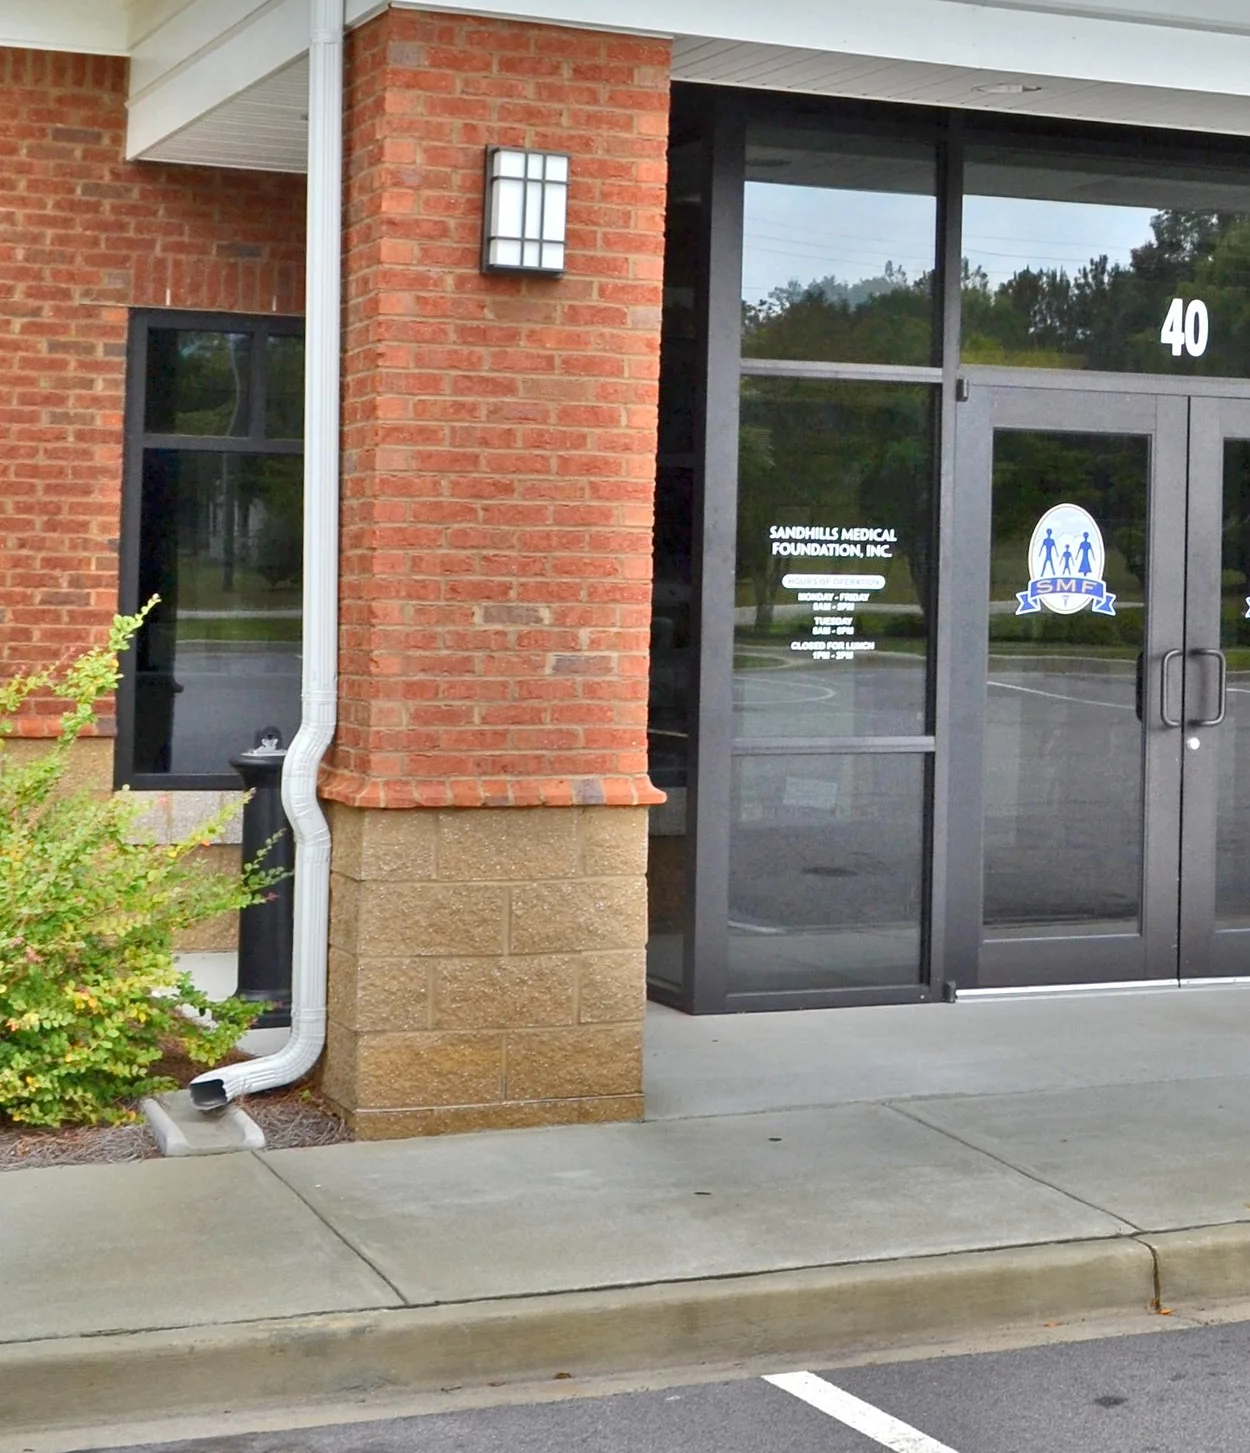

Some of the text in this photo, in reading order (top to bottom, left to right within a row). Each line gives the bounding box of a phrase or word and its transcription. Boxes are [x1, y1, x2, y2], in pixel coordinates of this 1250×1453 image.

[1161, 298, 1209, 357] 40
[769, 525, 897, 542] SANDHILLS MEDICAL
[772, 542, 893, 558] FOUNDATION, INC.
[788, 577, 880, 587] HOURS OF OPERATION
[1036, 578, 1098, 594] SMF
[797, 592, 835, 601] MONDAY
[839, 593, 870, 602] FRIDAY
[813, 616, 853, 626] TUESDAY
[790, 641, 875, 650] CLOSED FOR LUNCH
